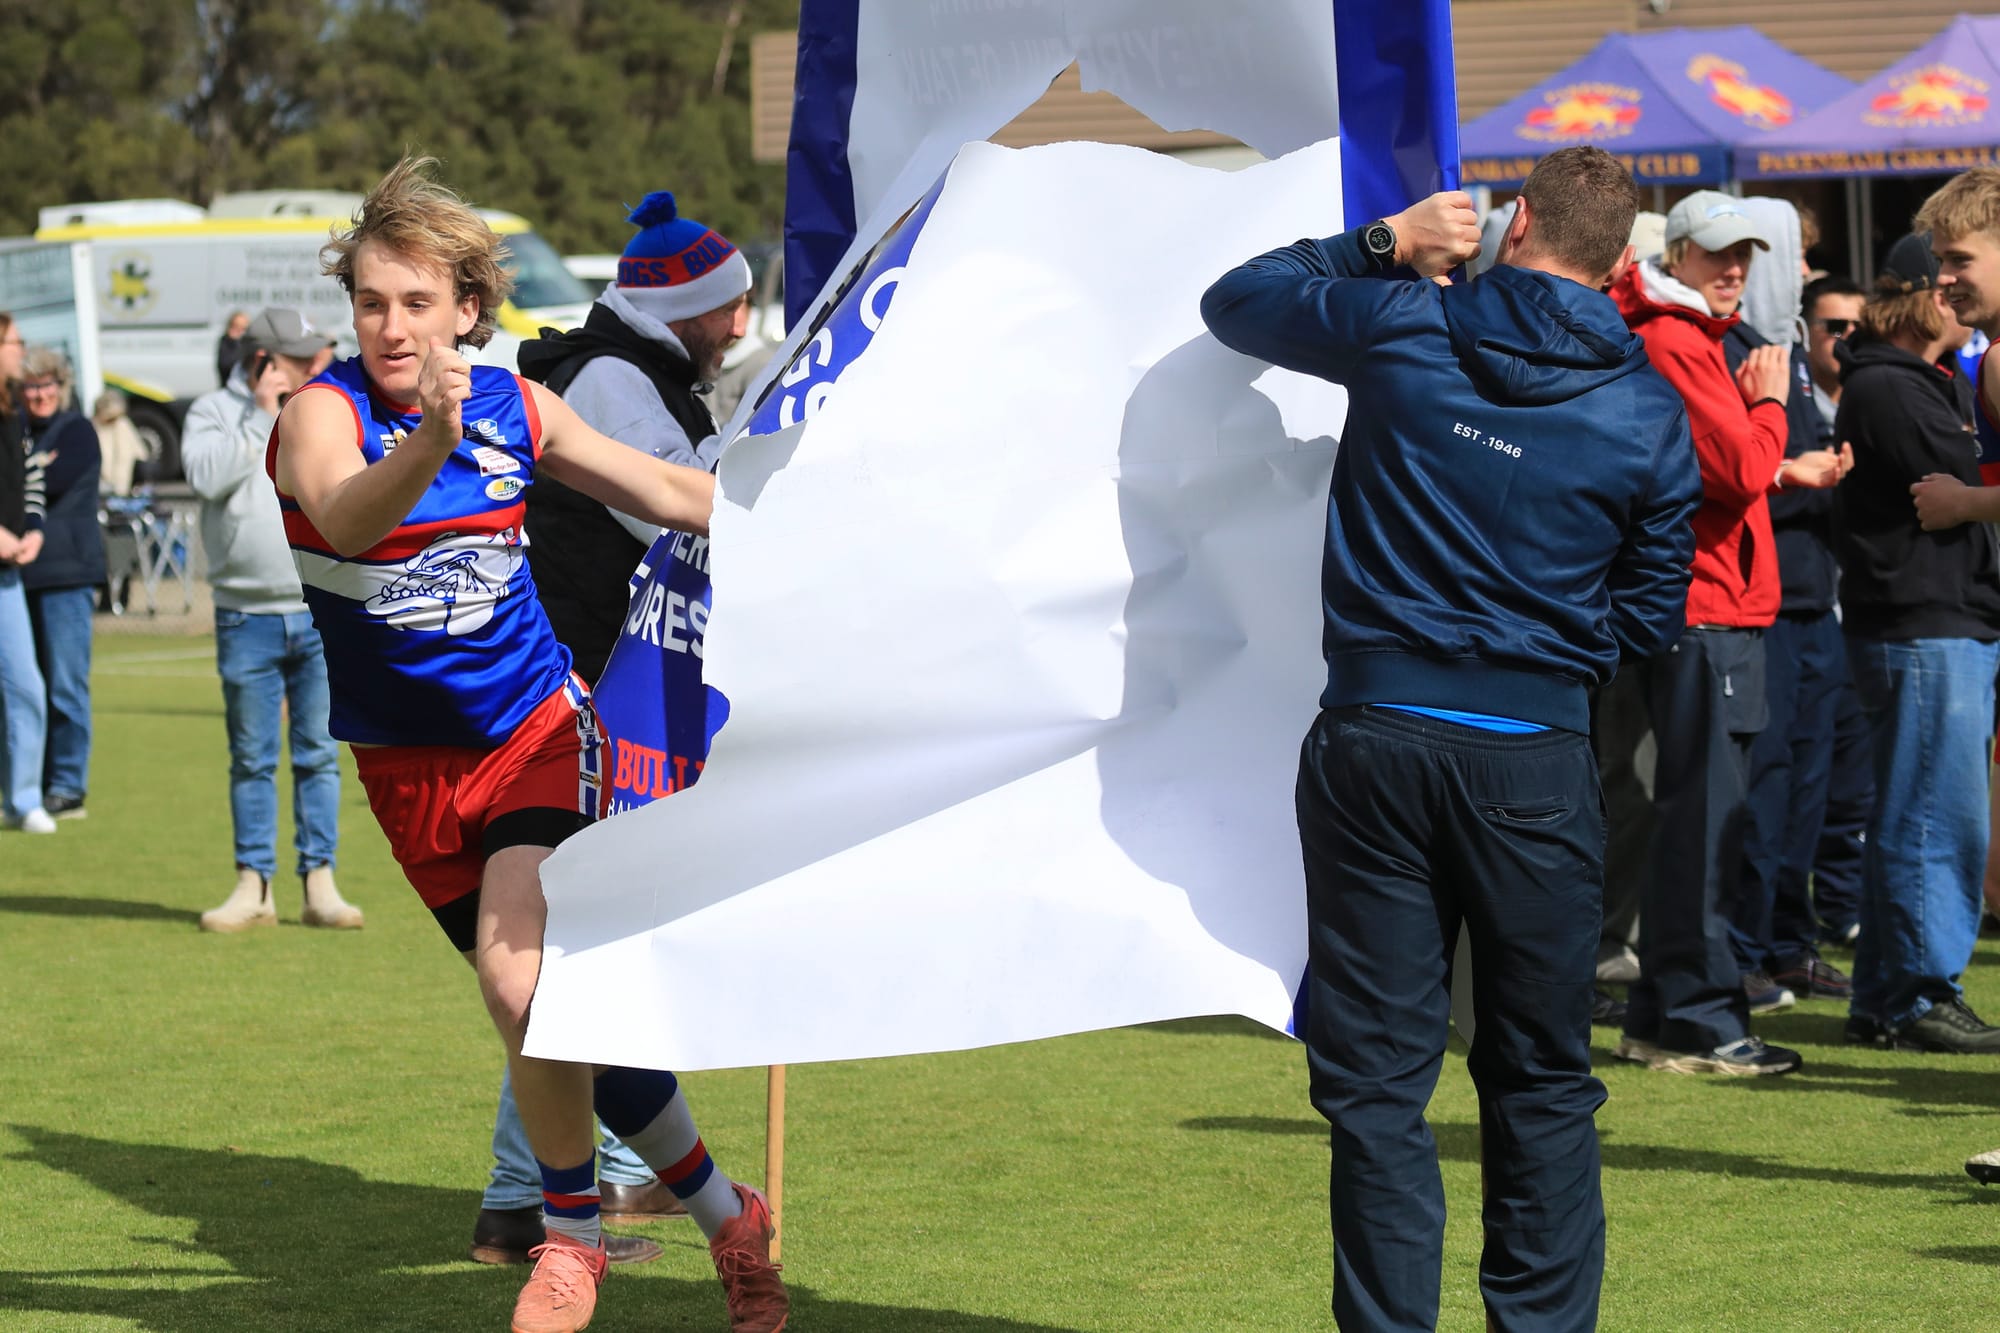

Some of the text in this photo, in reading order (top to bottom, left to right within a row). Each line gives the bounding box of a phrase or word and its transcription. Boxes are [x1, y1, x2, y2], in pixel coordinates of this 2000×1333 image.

[1637, 153, 1700, 177] CLUB
[617, 230, 736, 286] OGS BUL
[503, 480, 519, 490] RSL
[614, 738, 705, 799] BULL
